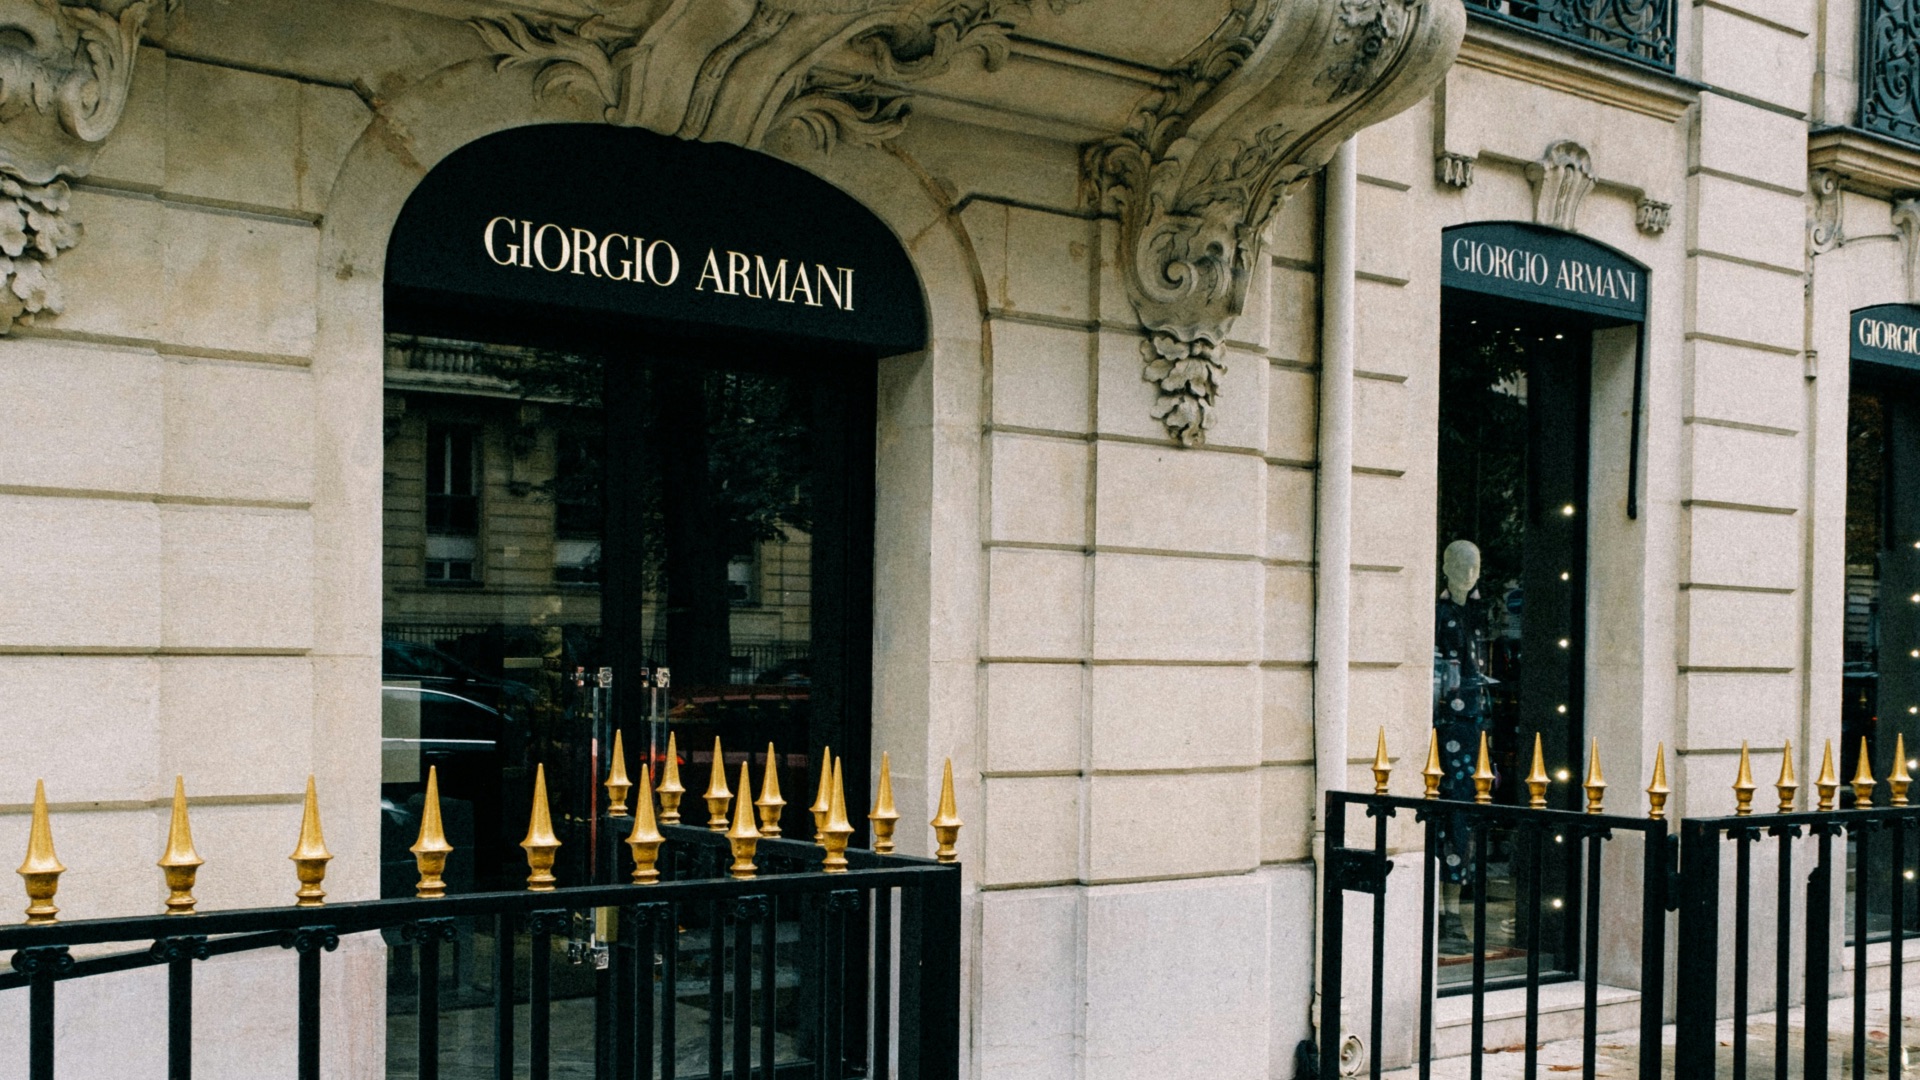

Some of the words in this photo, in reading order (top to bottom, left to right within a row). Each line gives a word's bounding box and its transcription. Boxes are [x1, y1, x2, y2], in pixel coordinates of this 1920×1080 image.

[484, 216, 680, 287] GIORGIO
[695, 248, 855, 311] ARMANI
[1452, 238, 1549, 286] GIORGIO
[1555, 259, 1636, 302] ARMANI
